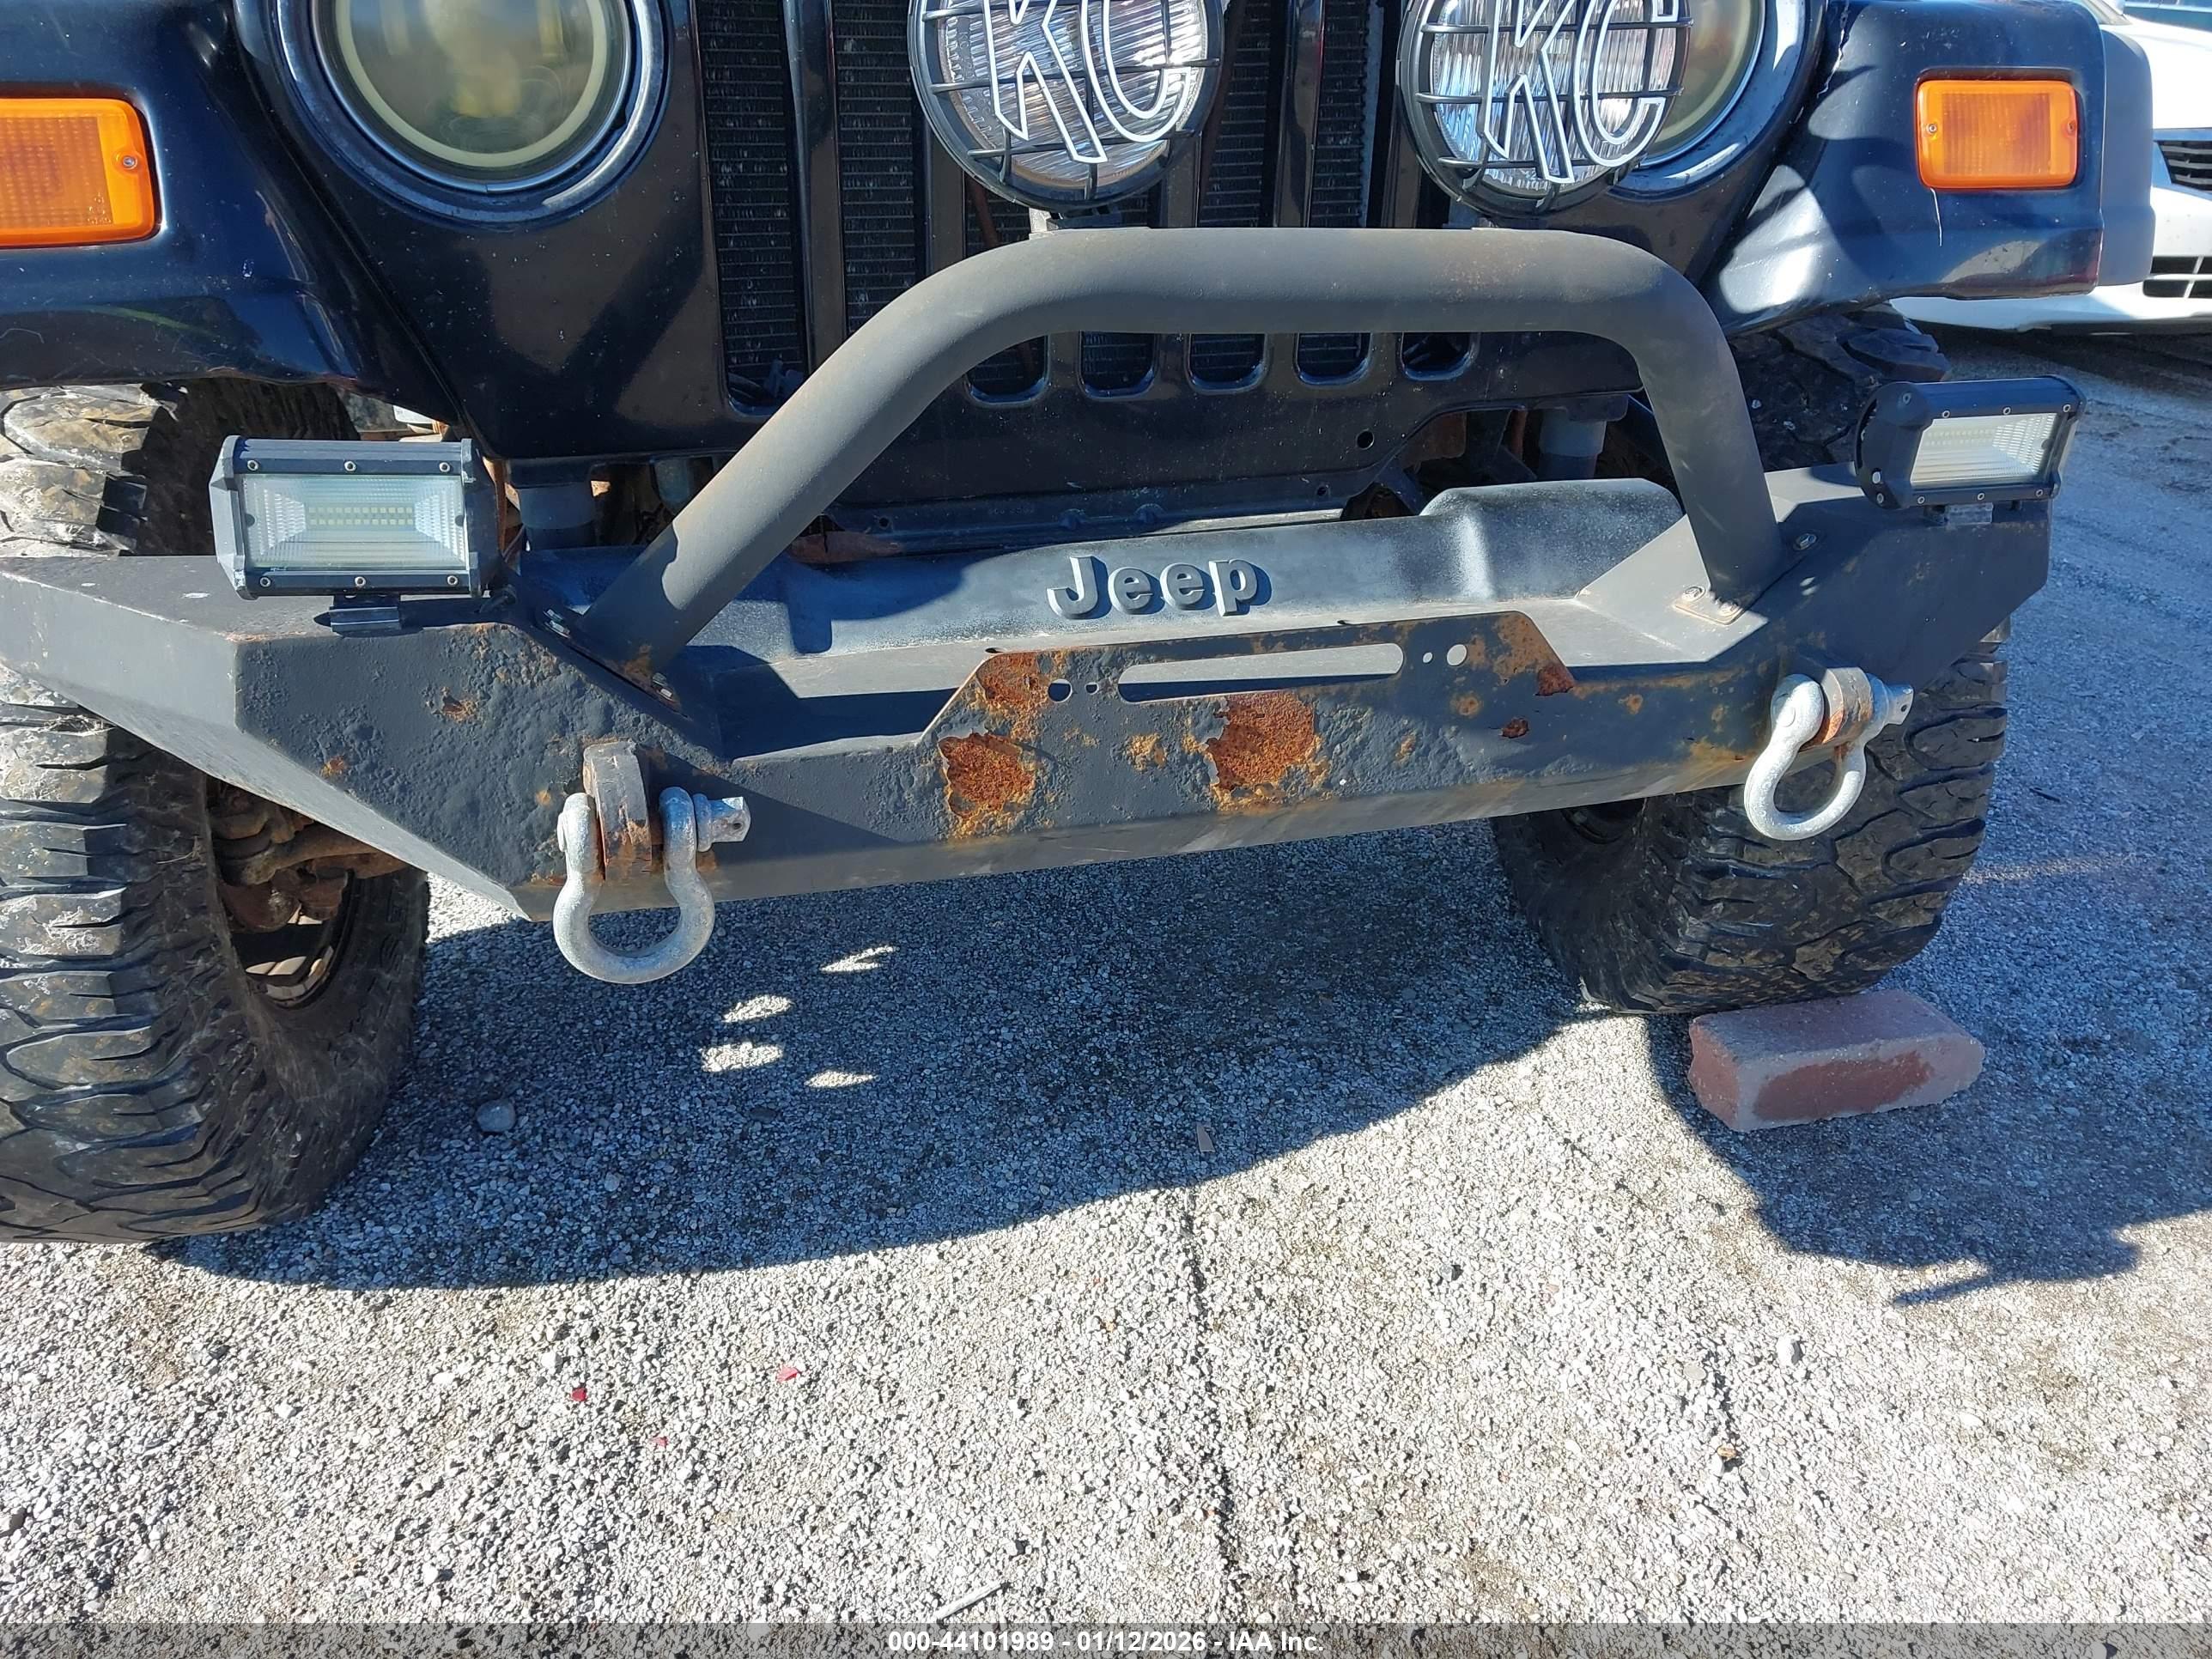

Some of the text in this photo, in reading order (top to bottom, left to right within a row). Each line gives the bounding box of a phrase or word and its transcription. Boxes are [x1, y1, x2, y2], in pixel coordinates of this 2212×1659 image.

[982, 0, 1192, 164] KC
[1483, 0, 1680, 184] KC
[1046, 555, 1260, 620] Jeep
